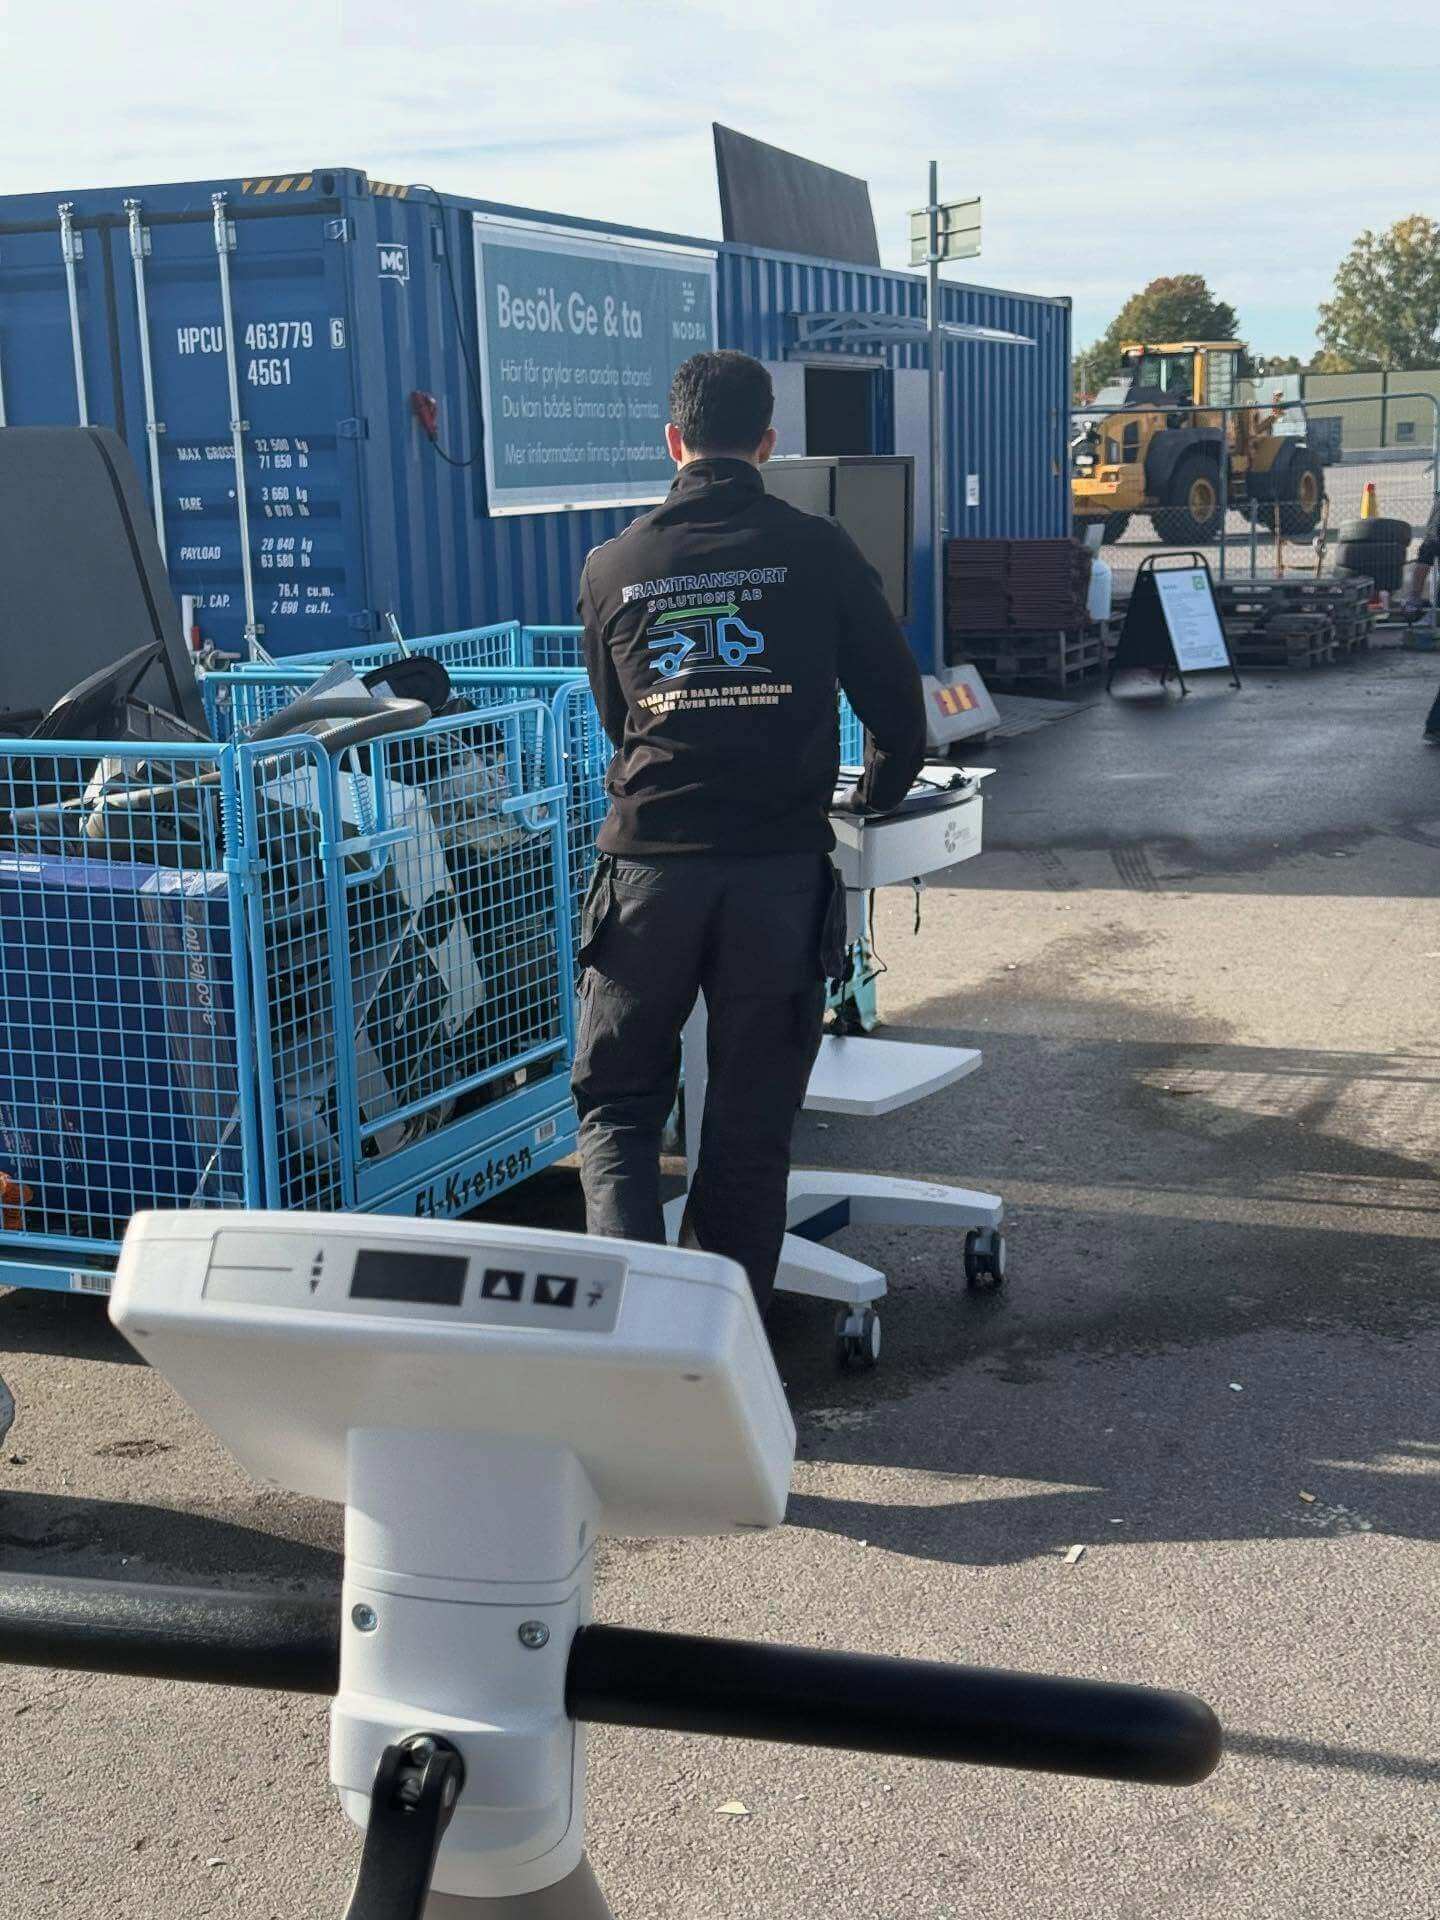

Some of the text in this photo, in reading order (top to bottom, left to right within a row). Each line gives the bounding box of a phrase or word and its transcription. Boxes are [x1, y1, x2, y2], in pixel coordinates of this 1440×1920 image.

[380, 251, 404, 271] MC
[497, 284, 643, 339] Besök Ge & ta
[177, 320, 345, 354] HPCU 463779 6
[248, 358, 291, 386] 45G1
[502, 395, 519, 417] Du
[259, 455, 270, 469] 71
[179, 497, 203, 511] TARE
[262, 487, 269, 501] 3
[180, 547, 221, 561] PAYLOAD
[301, 537, 313, 552] kg
[261, 555, 273, 568] 63
[301, 553, 311, 568] lb
[210, 594, 230, 608] CAP.
[279, 584, 299, 598] 76.4
[621, 567, 788, 603] FRAMTRANSPORT
[271, 602, 278, 614] 2
[647, 589, 763, 613] SOLUTIONS AB
[415, 1146, 532, 1217] El-Kretsen
